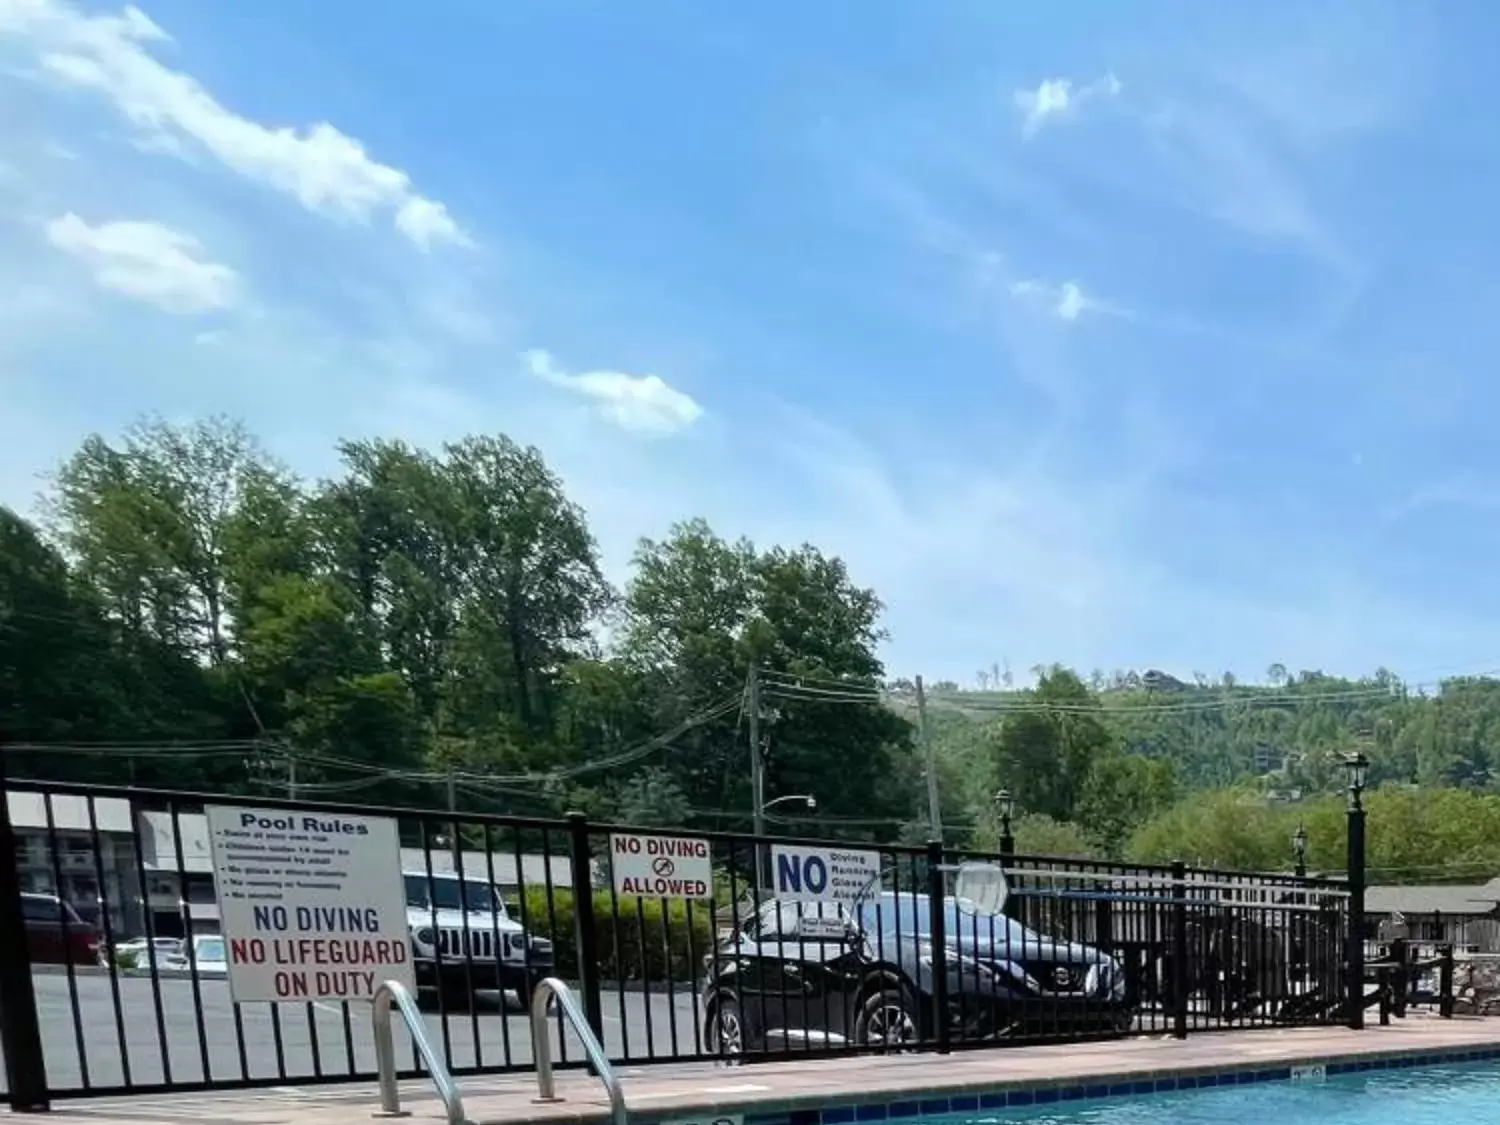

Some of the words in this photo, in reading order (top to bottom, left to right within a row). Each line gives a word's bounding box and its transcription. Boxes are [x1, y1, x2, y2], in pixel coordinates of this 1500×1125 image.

[240, 813, 295, 830] Pool
[302, 817, 369, 835] Rules
[615, 837, 641, 854] NO
[647, 839, 707, 858] DIVING
[778, 853, 828, 894] NO
[831, 866, 875, 875] Runnin
[623, 877, 707, 895] ALLOWED
[253, 905, 288, 931] NO
[296, 907, 380, 932] DIVING
[231, 939, 266, 964] NO
[272, 939, 406, 964] LIFEGUARD
[275, 971, 309, 996] ON
[316, 971, 375, 996] DUTY
